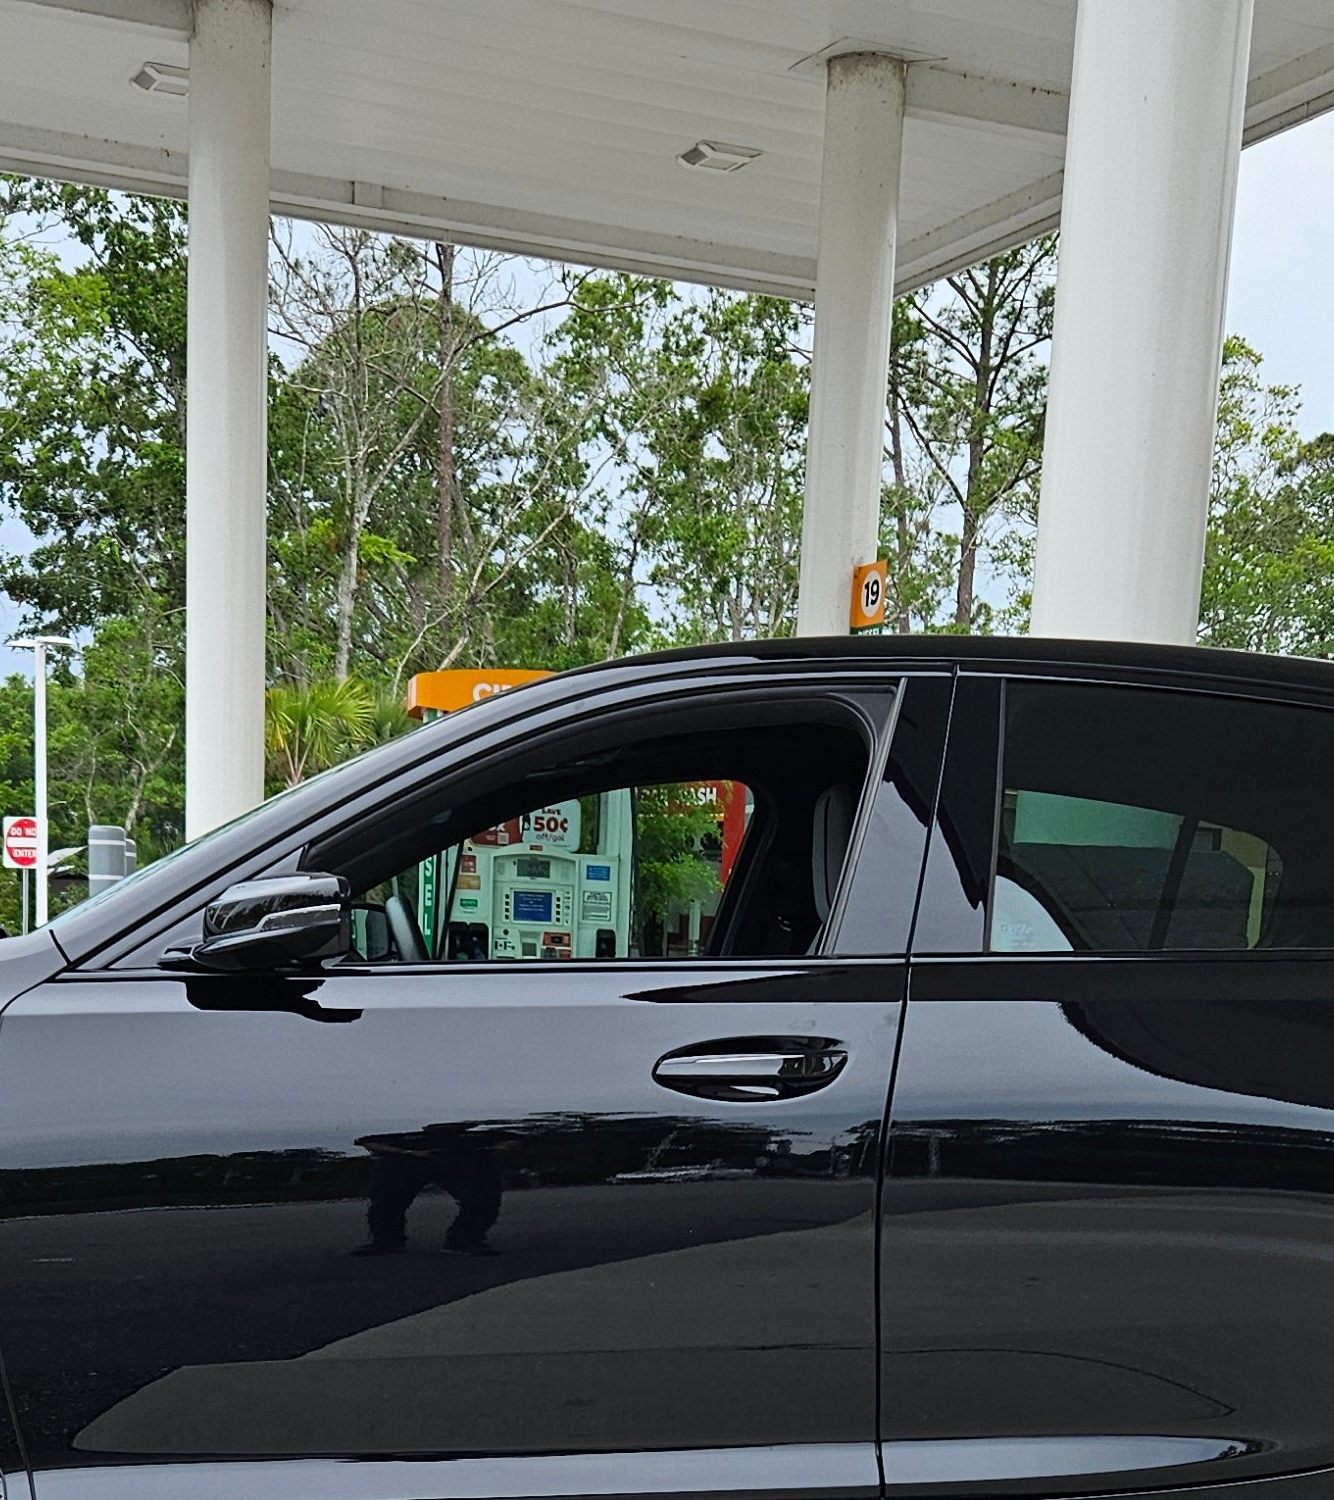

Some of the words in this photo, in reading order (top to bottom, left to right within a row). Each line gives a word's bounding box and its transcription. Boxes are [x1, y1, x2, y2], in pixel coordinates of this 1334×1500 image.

[864, 579, 880, 608] 19
[10, 827, 22, 836] DO
[25, 827, 37, 836] NO
[533, 816, 569, 833] 50¢
[423, 856, 433, 936] SEL
